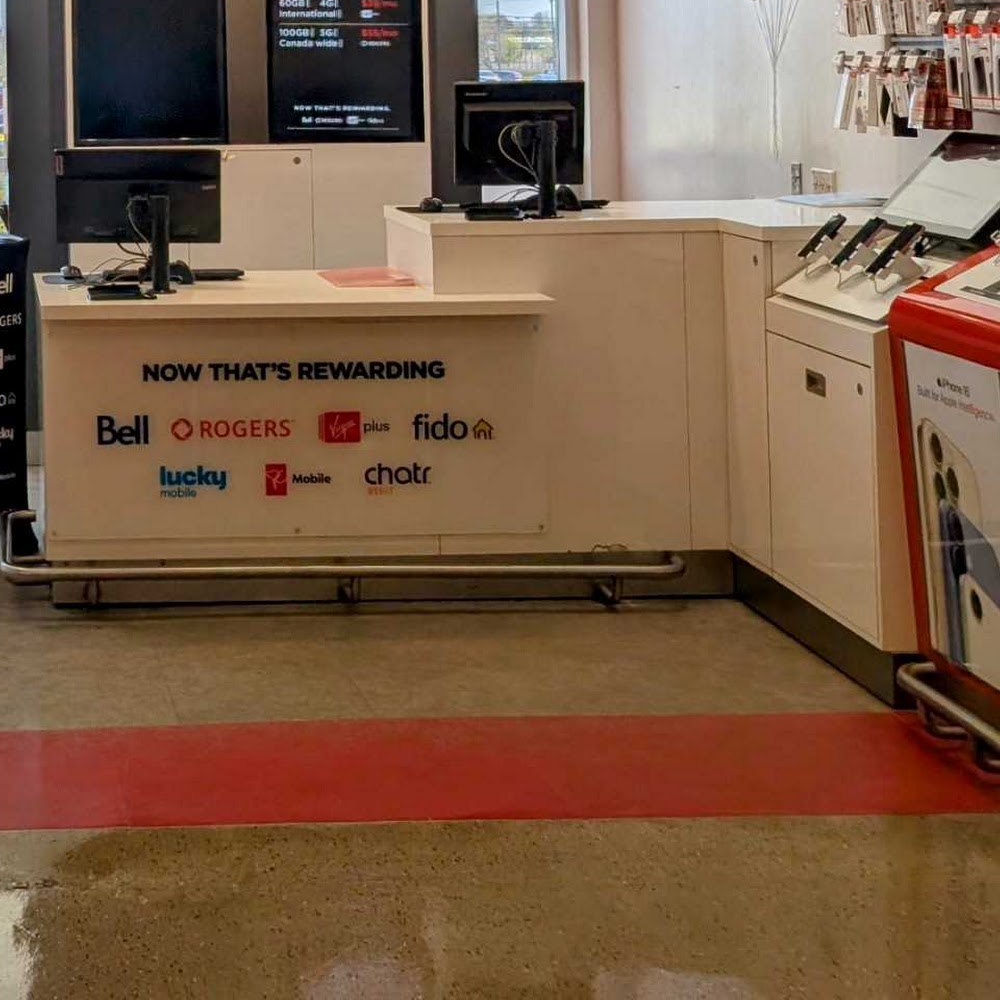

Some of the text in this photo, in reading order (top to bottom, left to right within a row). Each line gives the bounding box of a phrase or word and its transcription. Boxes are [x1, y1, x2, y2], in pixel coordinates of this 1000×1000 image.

[142, 360, 446, 382] NOW THAT'S REWARDING
[97, 415, 149, 445] Bell
[201, 419, 292, 438] ROGERS
[363, 420, 390, 434] plus
[412, 412, 468, 441] fido
[160, 466, 227, 490] lucky
[292, 473, 332, 484] Mobile
[364, 462, 432, 485] chatr
[160, 487, 198, 498] mobile
